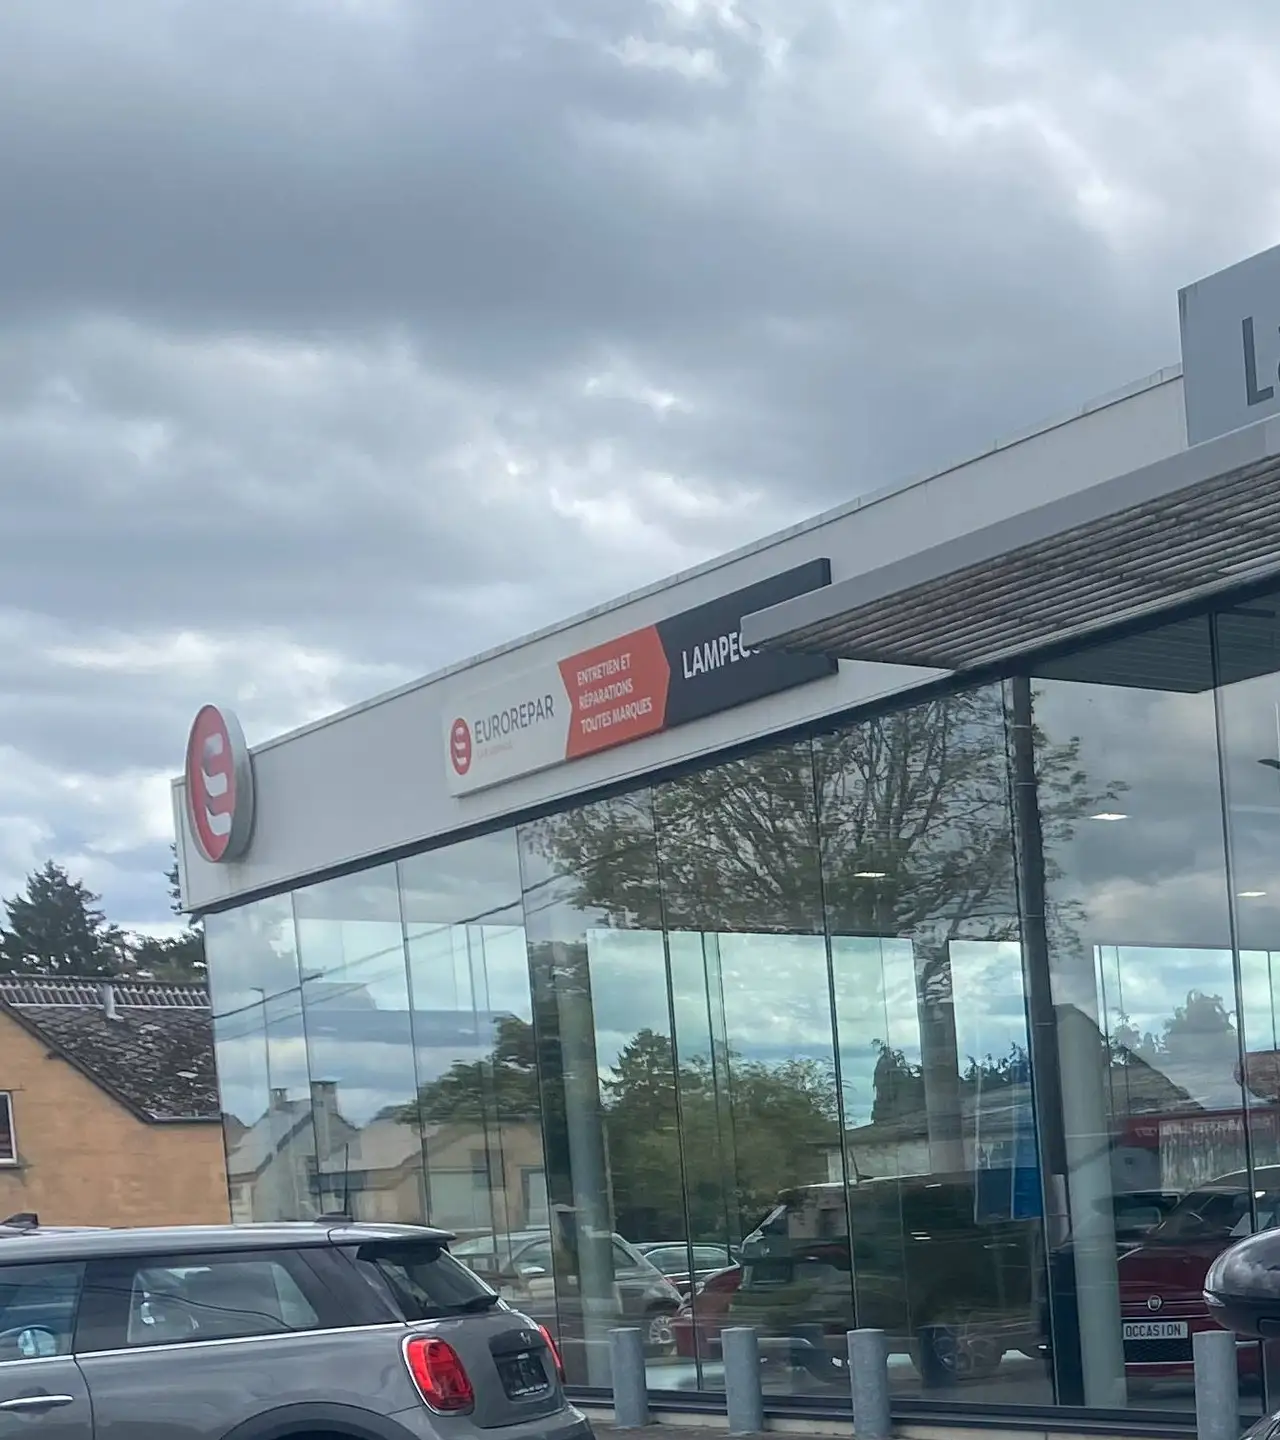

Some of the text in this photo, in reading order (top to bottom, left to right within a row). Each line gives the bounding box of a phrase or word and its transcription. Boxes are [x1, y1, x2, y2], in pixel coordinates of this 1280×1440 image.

[577, 653, 631, 686] ENTRETIEN ET
[579, 677, 634, 711] RÉPARATIONS
[474, 694, 555, 745] EUROREPAR
[580, 697, 652, 735] TOUTES MARQUES
[1125, 1323, 1181, 1338] OCCASION
